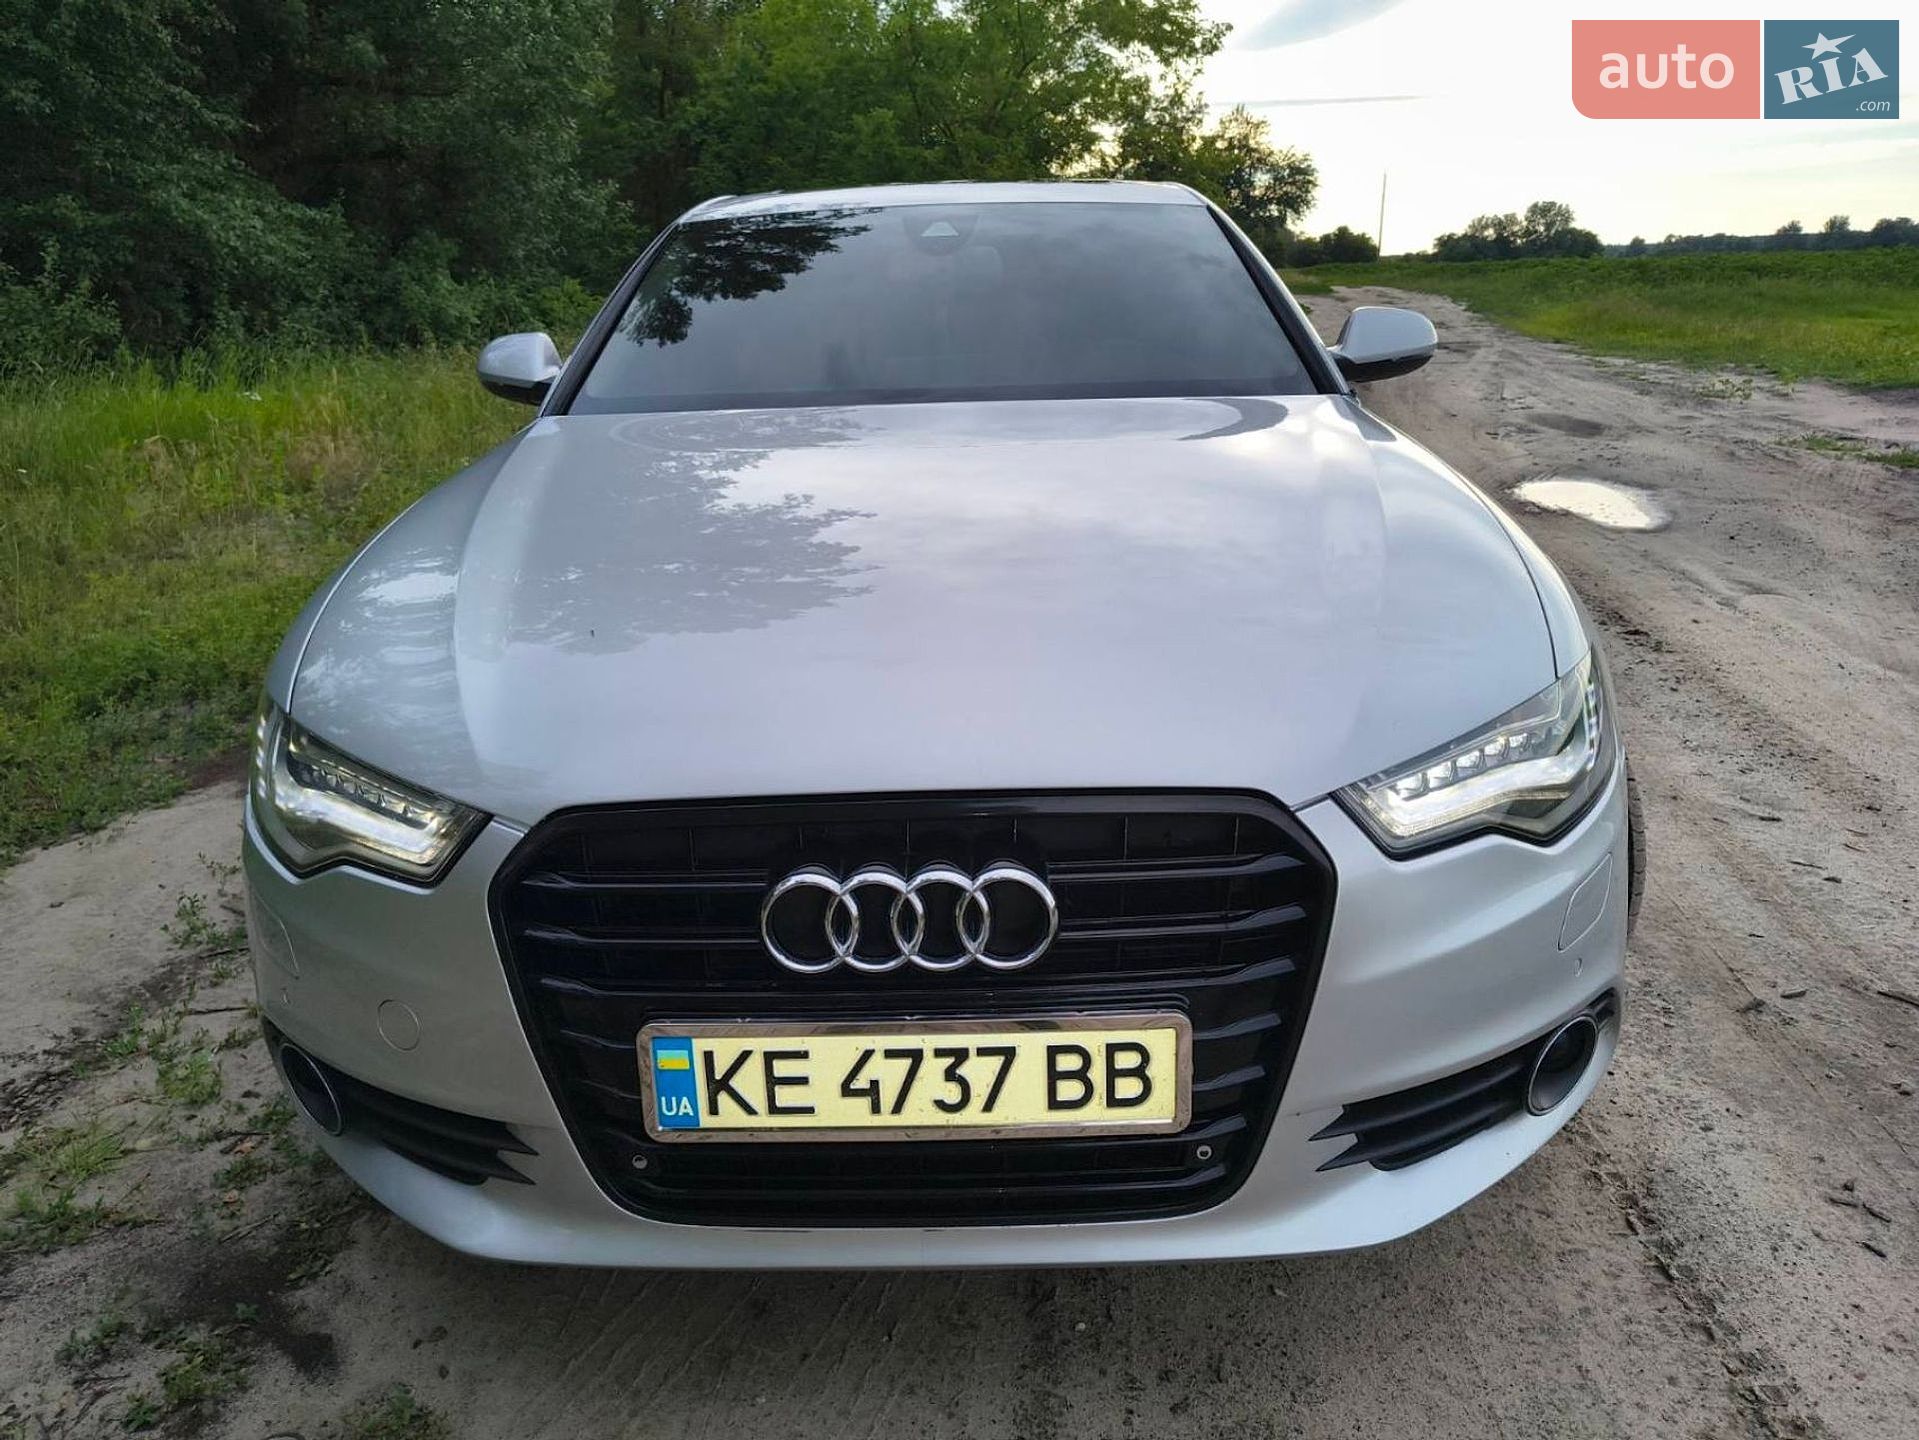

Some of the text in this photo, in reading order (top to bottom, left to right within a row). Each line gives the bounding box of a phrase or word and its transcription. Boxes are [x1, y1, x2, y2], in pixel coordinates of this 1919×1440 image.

[702, 1041, 1153, 1117] KE 4737 BB
[661, 1096, 695, 1117] UA
